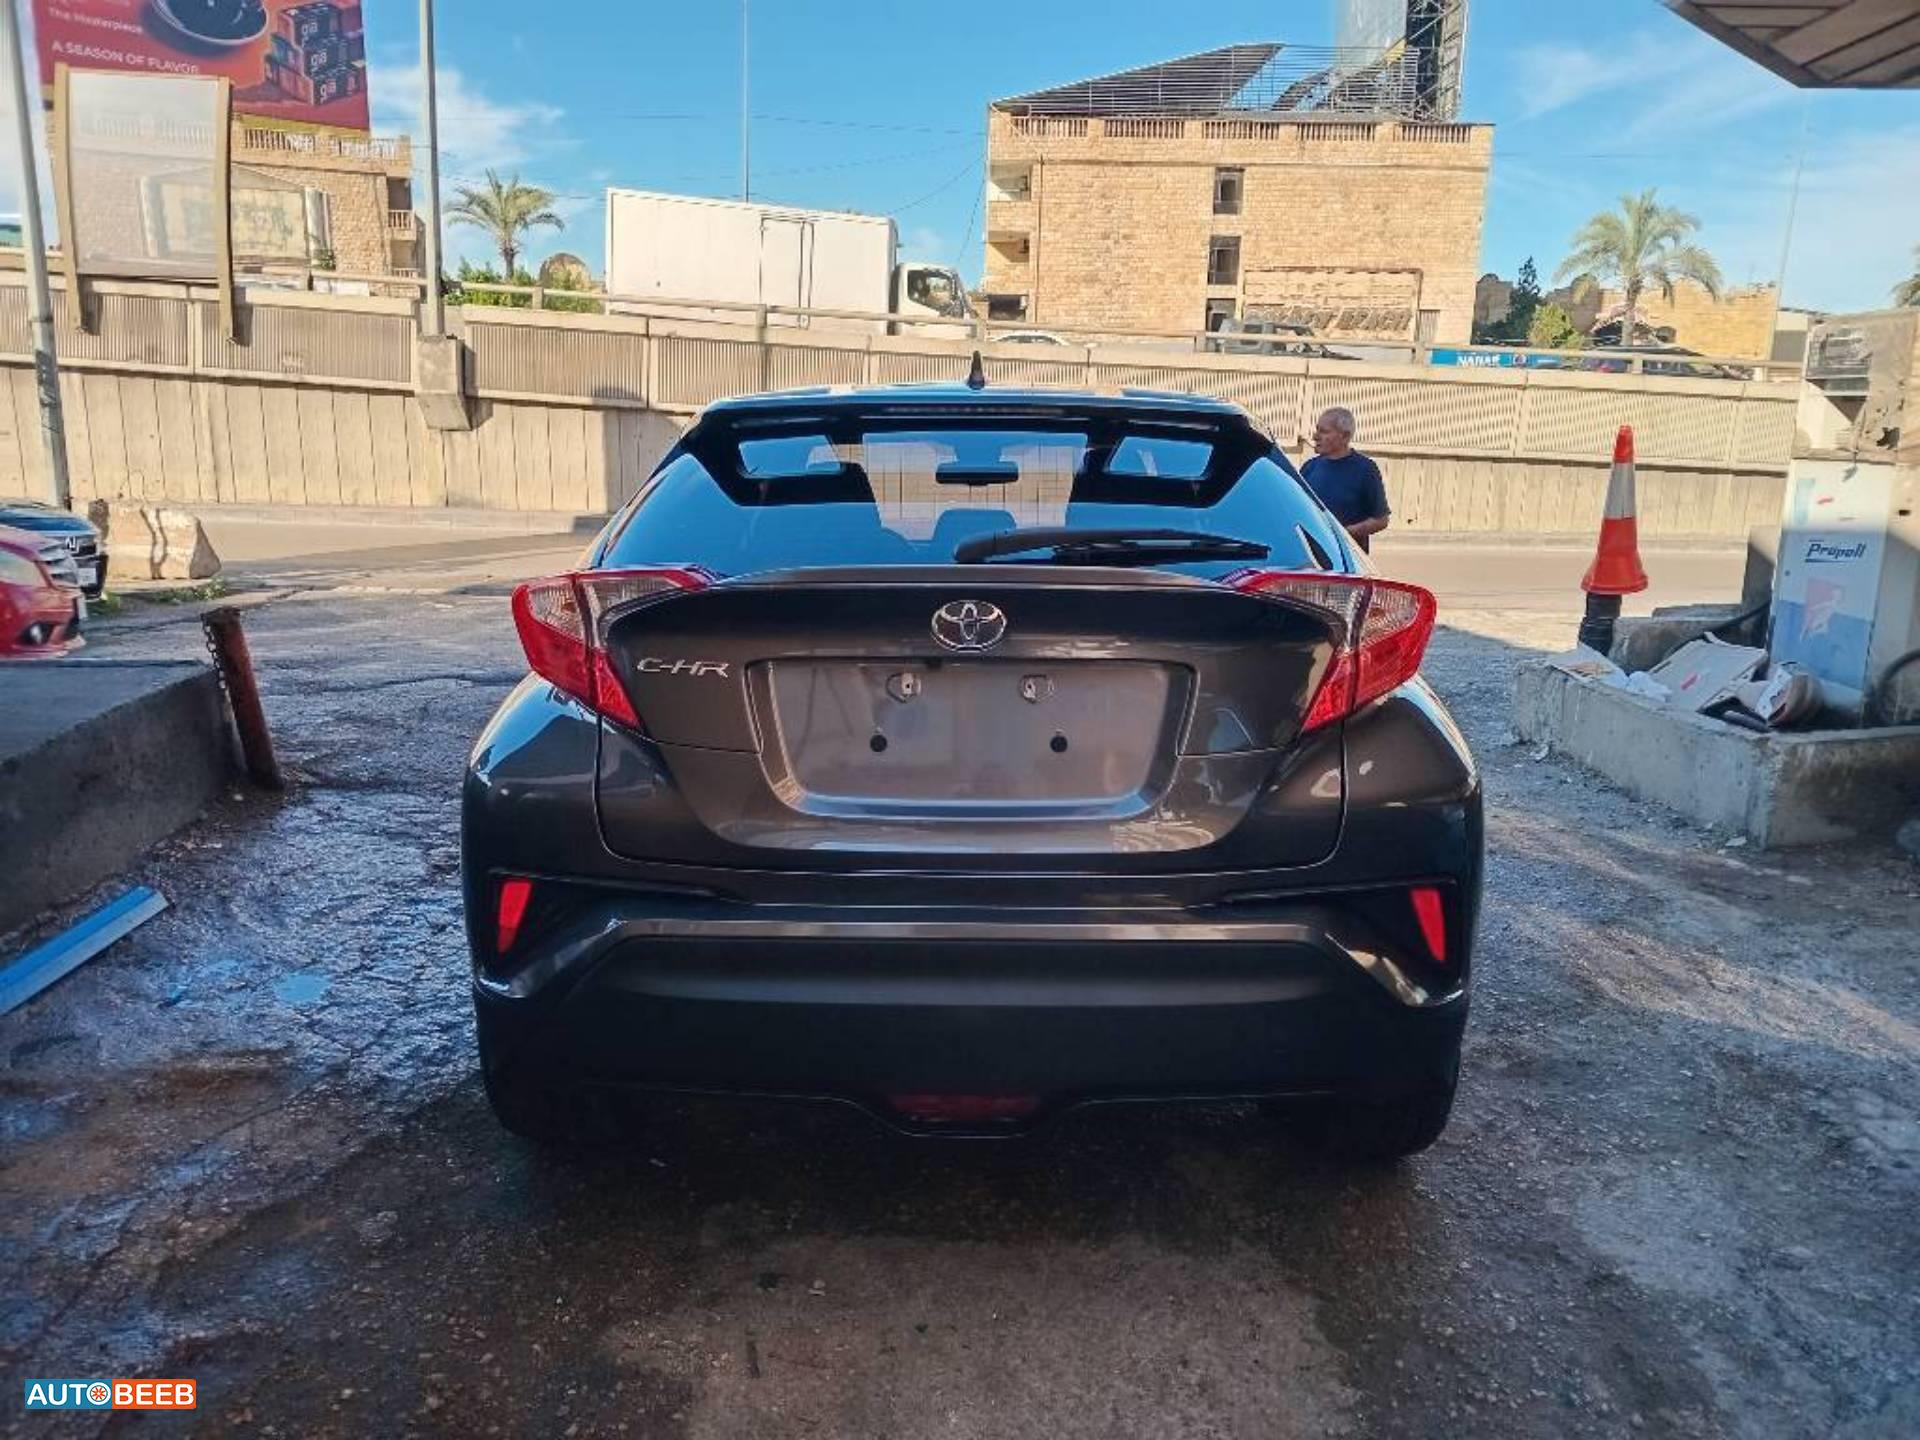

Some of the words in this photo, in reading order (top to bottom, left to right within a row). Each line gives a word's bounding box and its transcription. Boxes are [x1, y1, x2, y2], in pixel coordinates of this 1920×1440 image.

[65, 41, 123, 63] SEASON
[125, 52, 145, 66] OF
[148, 57, 200, 75] FLAVOR
[637, 657, 729, 678] C-HR
